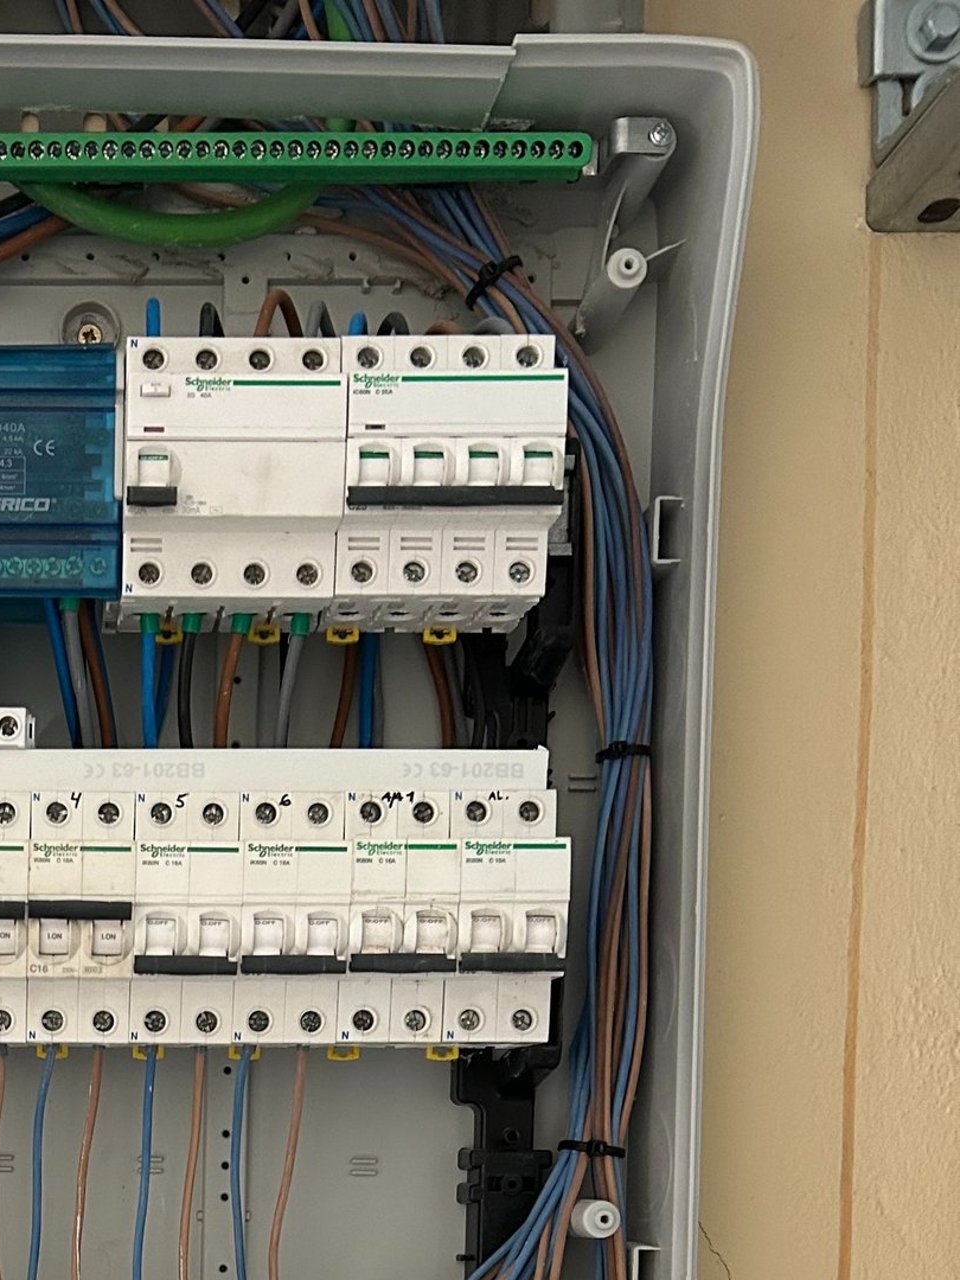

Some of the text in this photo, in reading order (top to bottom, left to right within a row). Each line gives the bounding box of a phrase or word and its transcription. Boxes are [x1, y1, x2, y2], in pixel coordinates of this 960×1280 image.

[130, 339, 138, 348] N
[185, 377, 231, 391] Schneider
[353, 374, 399, 388] Schneider
[125, 584, 133, 593] N
[33, 792, 40, 801] N
[71, 791, 81, 809] 4
[138, 793, 145, 802] N
[175, 792, 190, 808] 5
[242, 793, 249, 802] N
[279, 793, 292, 806] 6
[348, 792, 356, 801] N
[455, 792, 462, 800] N
[33, 843, 78, 858] Schneider
[140, 843, 186, 858] Schneider
[248, 843, 294, 858] Schneider
[356, 841, 403, 856] Schneider
[465, 841, 512, 855] Schneider
[29, 1030, 36, 1039] N
[131, 1031, 138, 1040] N
[234, 1031, 241, 1041] N
[341, 1030, 349, 1040] N
[447, 1030, 454, 1039] N
